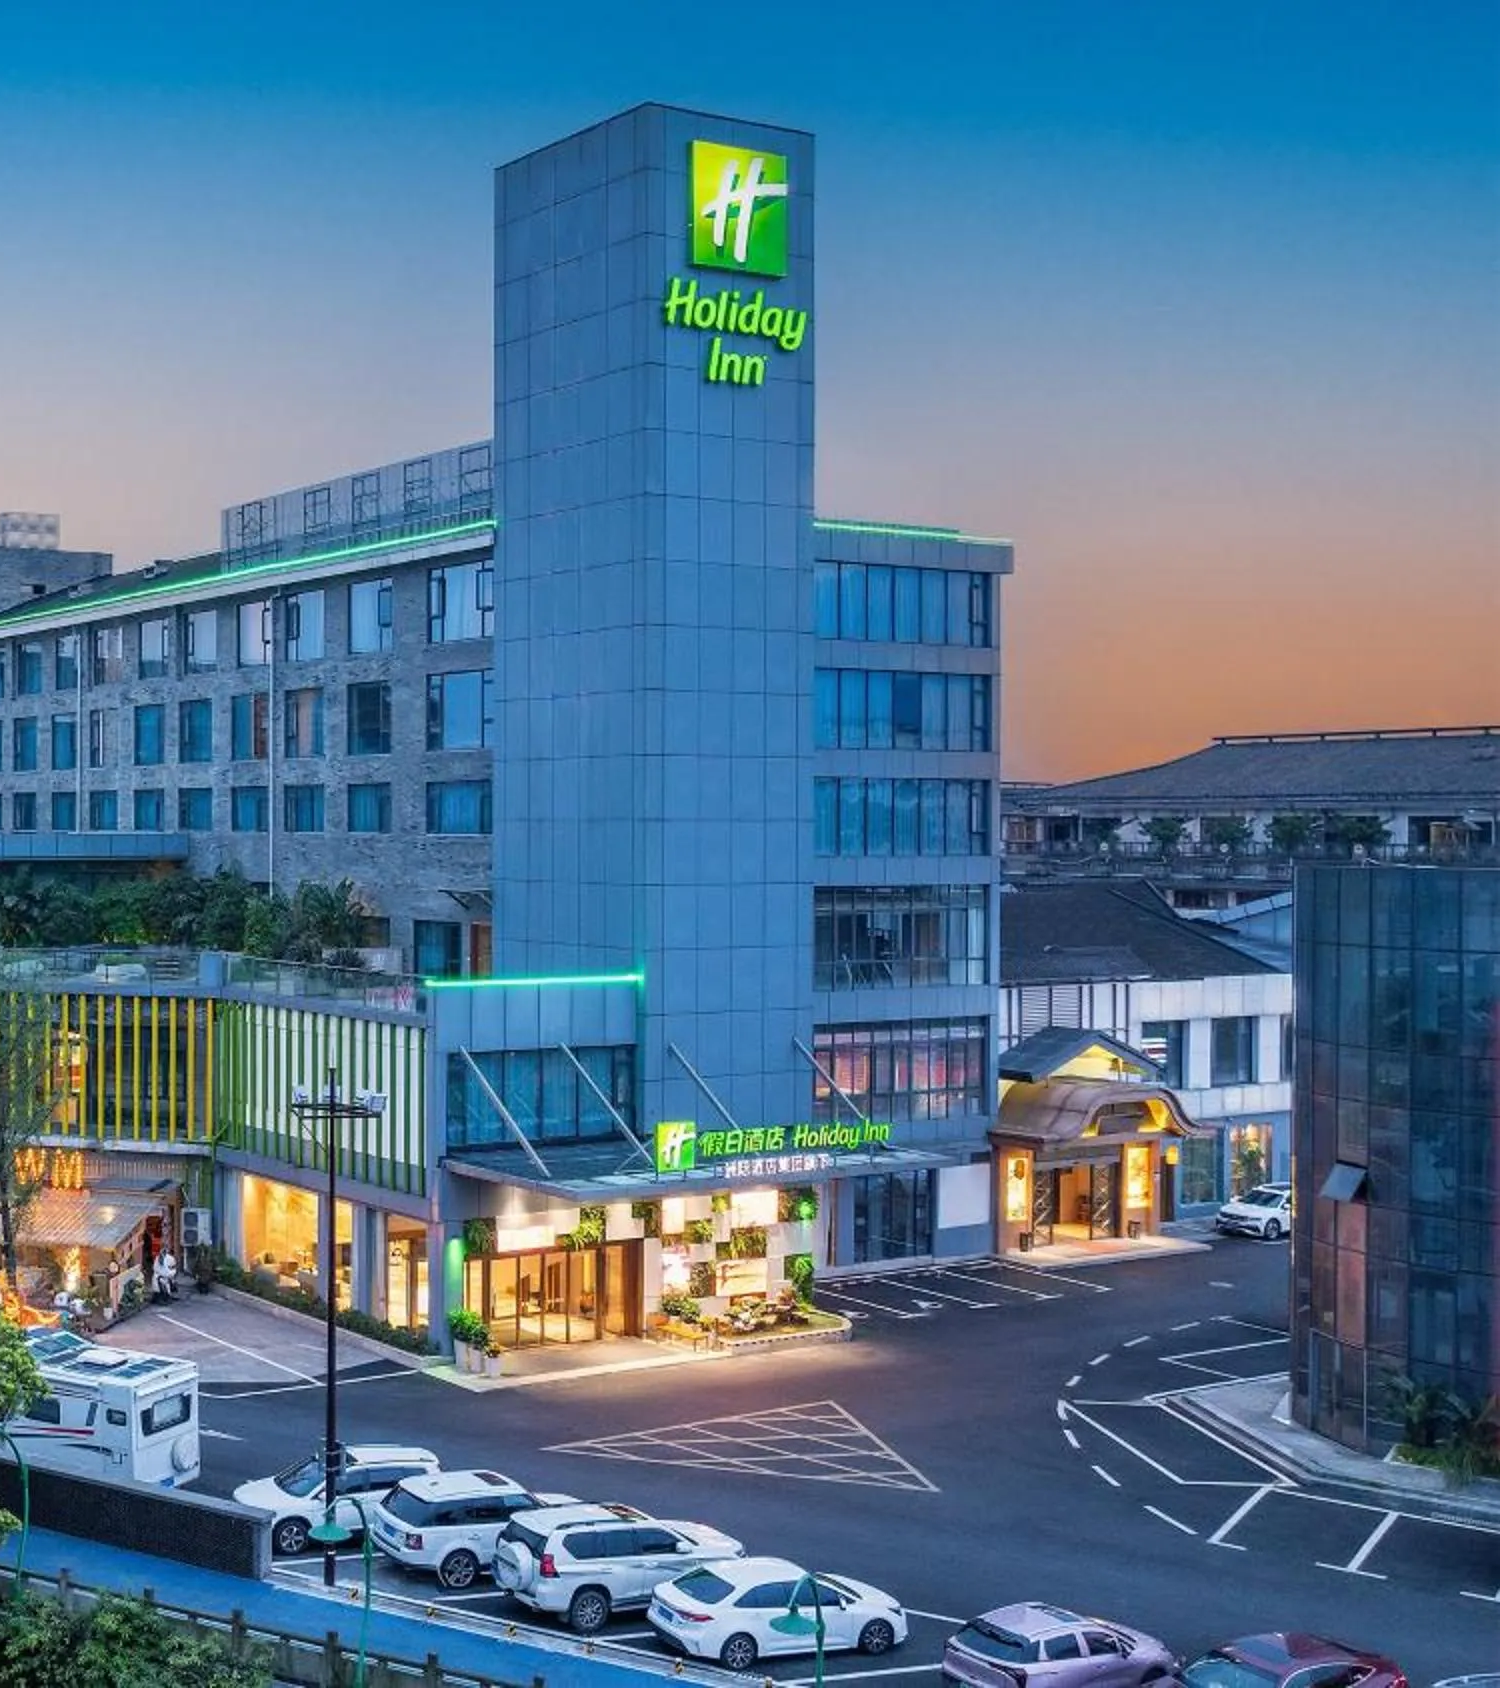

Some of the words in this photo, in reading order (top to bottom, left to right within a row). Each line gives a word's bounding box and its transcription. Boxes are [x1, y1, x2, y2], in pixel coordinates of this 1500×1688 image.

[665, 276, 807, 350] Holiday
[708, 336, 765, 385] Inn
[700, 1126, 785, 1157] 假日酒店
[794, 1120, 861, 1149] Holiday
[863, 1118, 890, 1141] Inn
